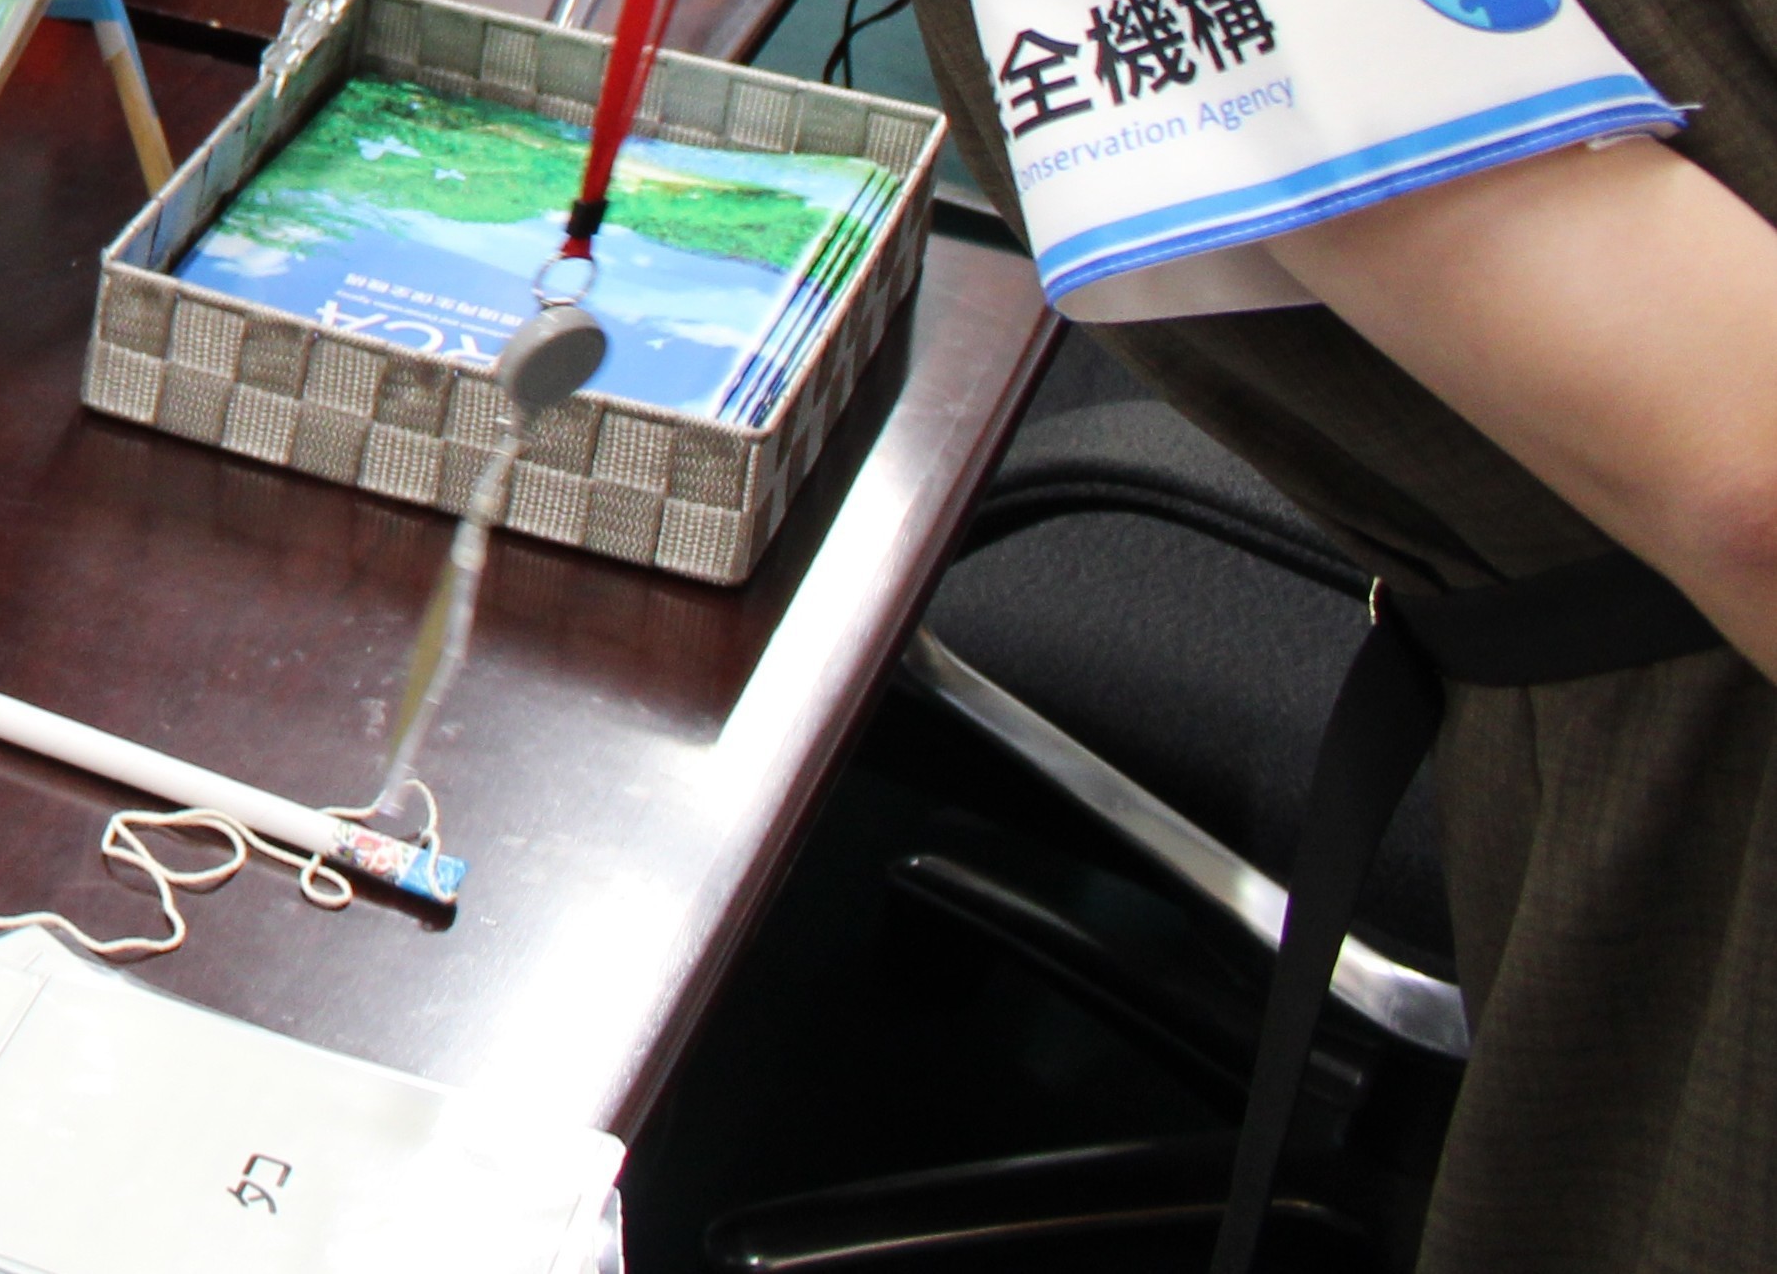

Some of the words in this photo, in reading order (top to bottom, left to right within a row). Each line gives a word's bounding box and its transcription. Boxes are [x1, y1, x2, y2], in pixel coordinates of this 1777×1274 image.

[1016, 115, 1188, 193] onservation
[1198, 76, 1296, 155] Agency
[315, 299, 499, 366] RCA
[225, 1152, 292, 1214] タコ
